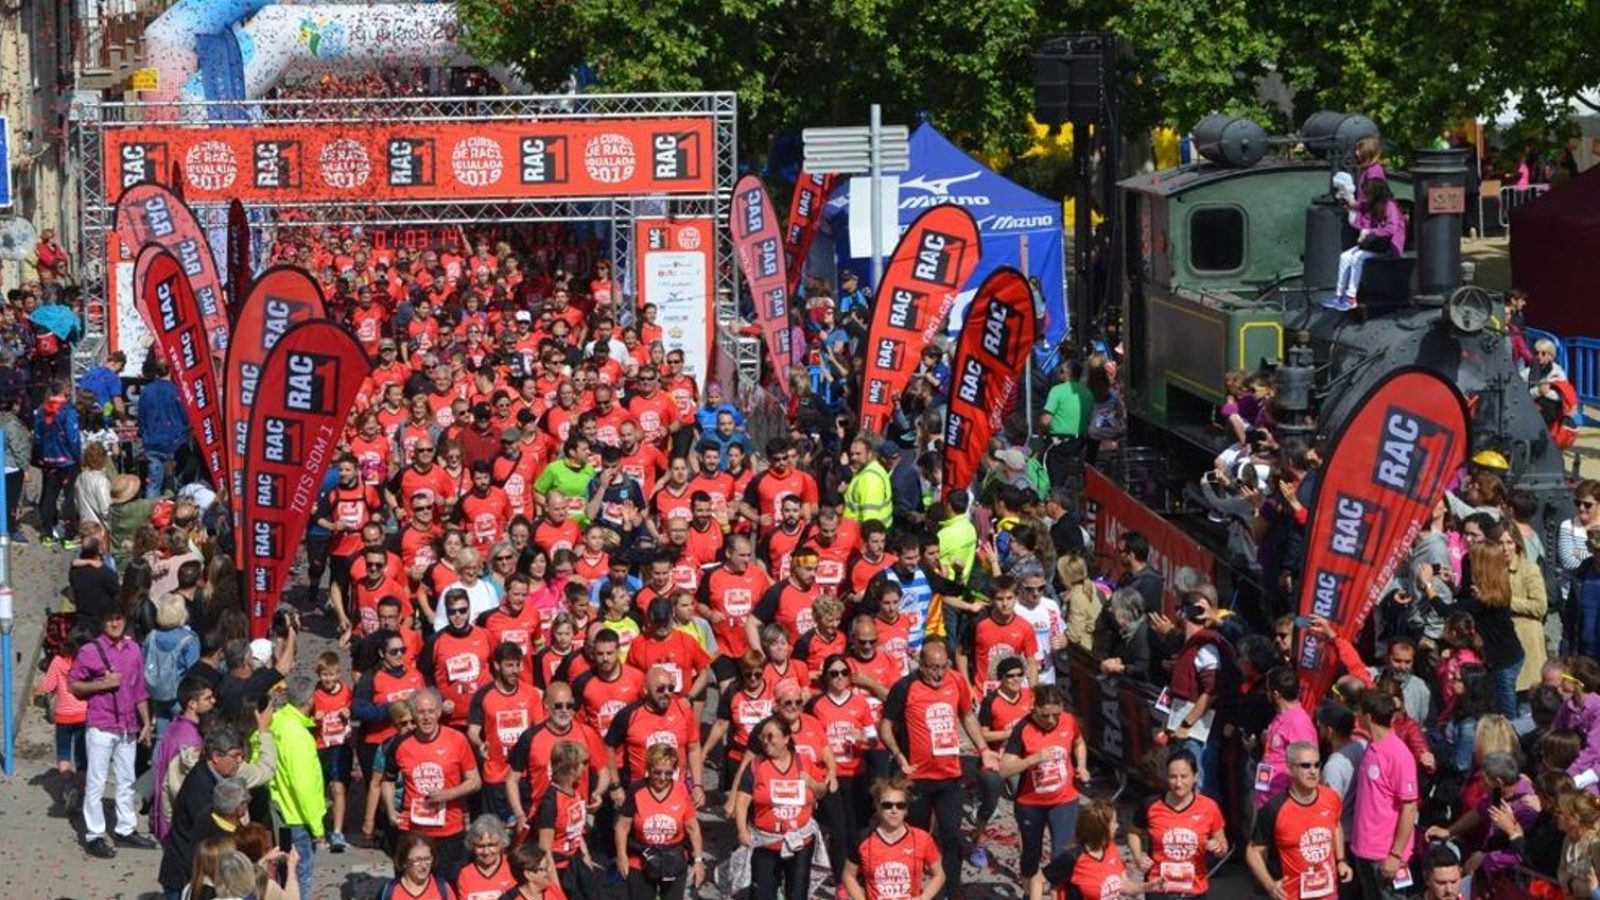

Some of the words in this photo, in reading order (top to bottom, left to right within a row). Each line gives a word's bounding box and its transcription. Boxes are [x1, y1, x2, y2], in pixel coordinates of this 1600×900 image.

[188, 172, 237, 190] 2019
[321, 171, 370, 188] 2019
[454, 169, 502, 186] 2019
[586, 166, 635, 183] 2019
